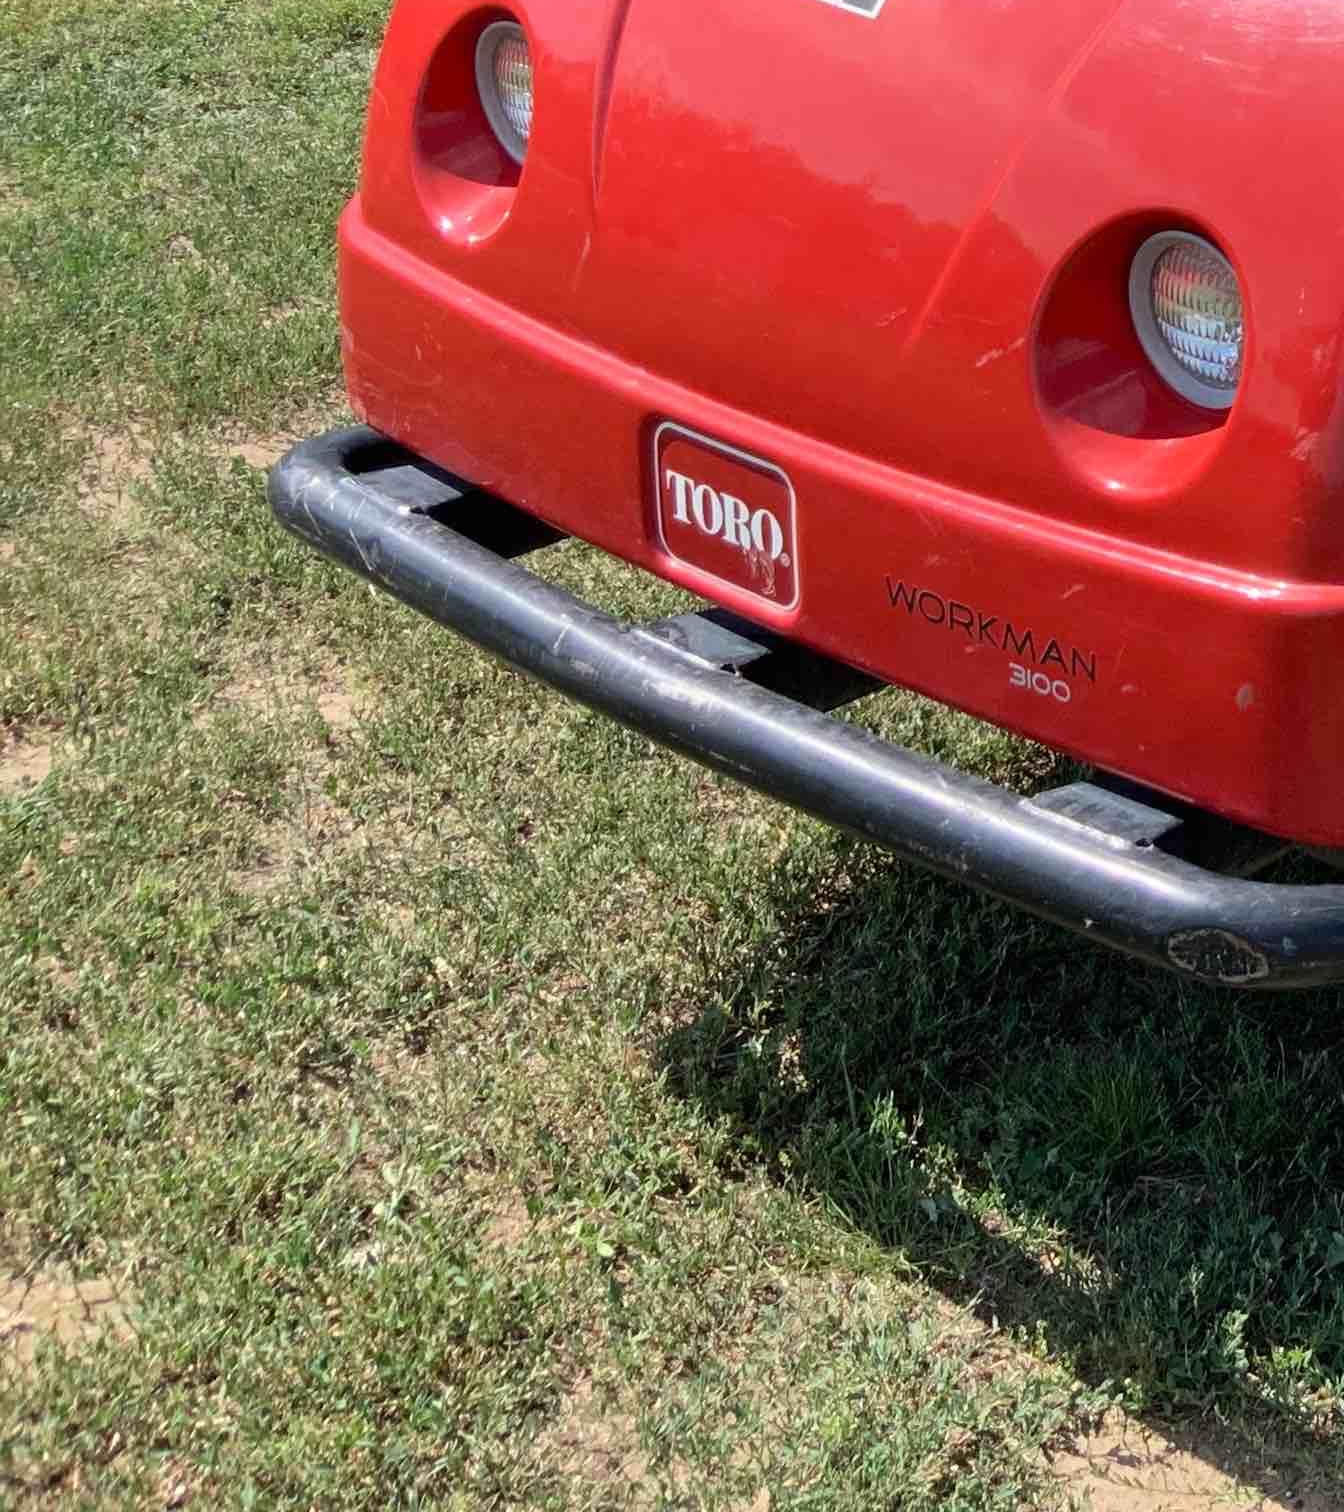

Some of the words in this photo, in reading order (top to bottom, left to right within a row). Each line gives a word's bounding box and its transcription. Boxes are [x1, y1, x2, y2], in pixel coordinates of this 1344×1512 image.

[665, 468, 784, 560] TORO
[885, 574, 1096, 682] WORKMAN
[1008, 661, 1071, 703] 3100
